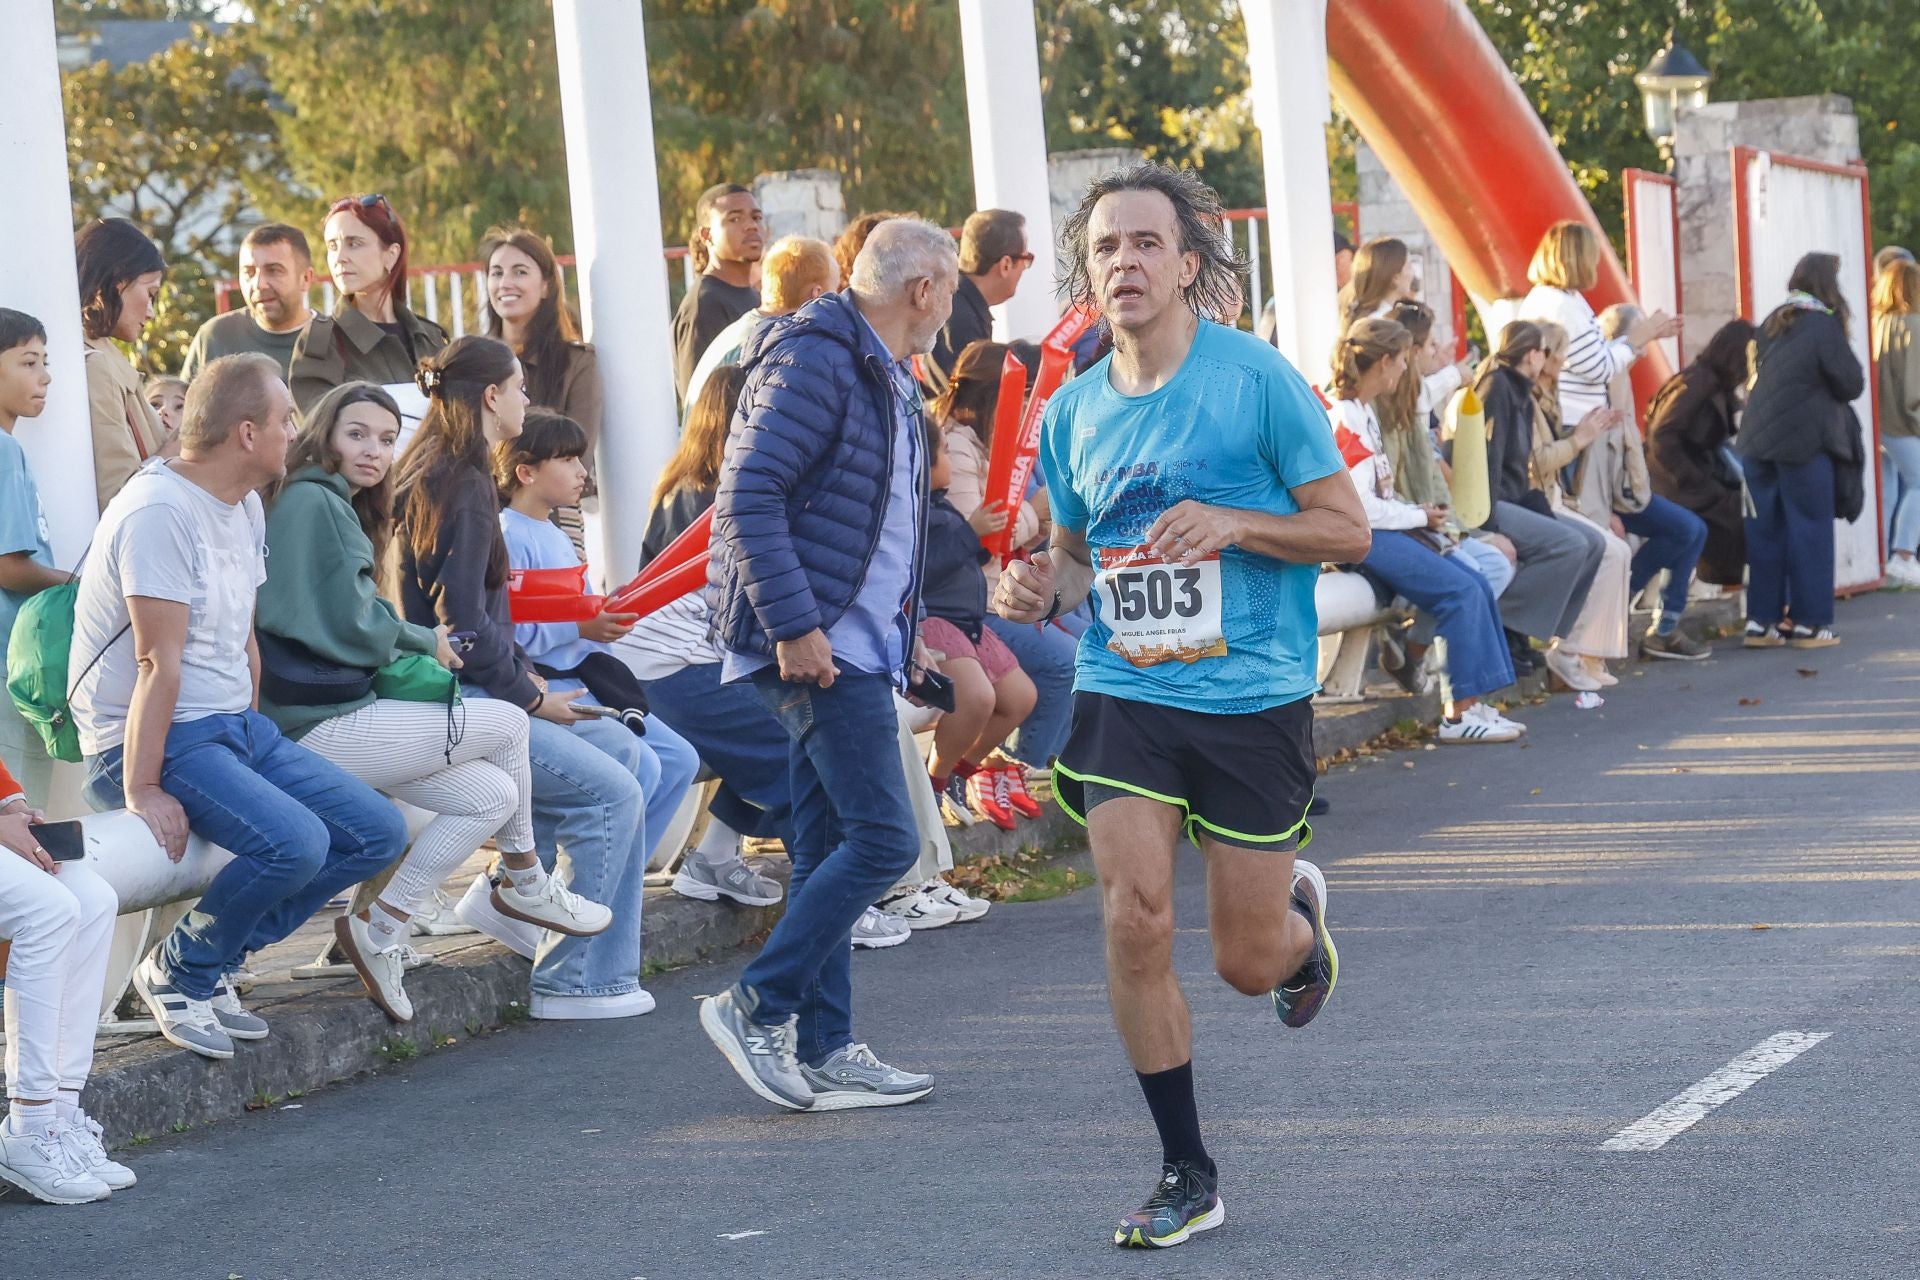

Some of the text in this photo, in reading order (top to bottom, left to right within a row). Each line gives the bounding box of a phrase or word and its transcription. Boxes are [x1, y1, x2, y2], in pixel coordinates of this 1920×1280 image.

[1008, 454, 1032, 506] MBA
[1118, 460, 1159, 481] MBA
[1105, 567, 1202, 621] 1503
